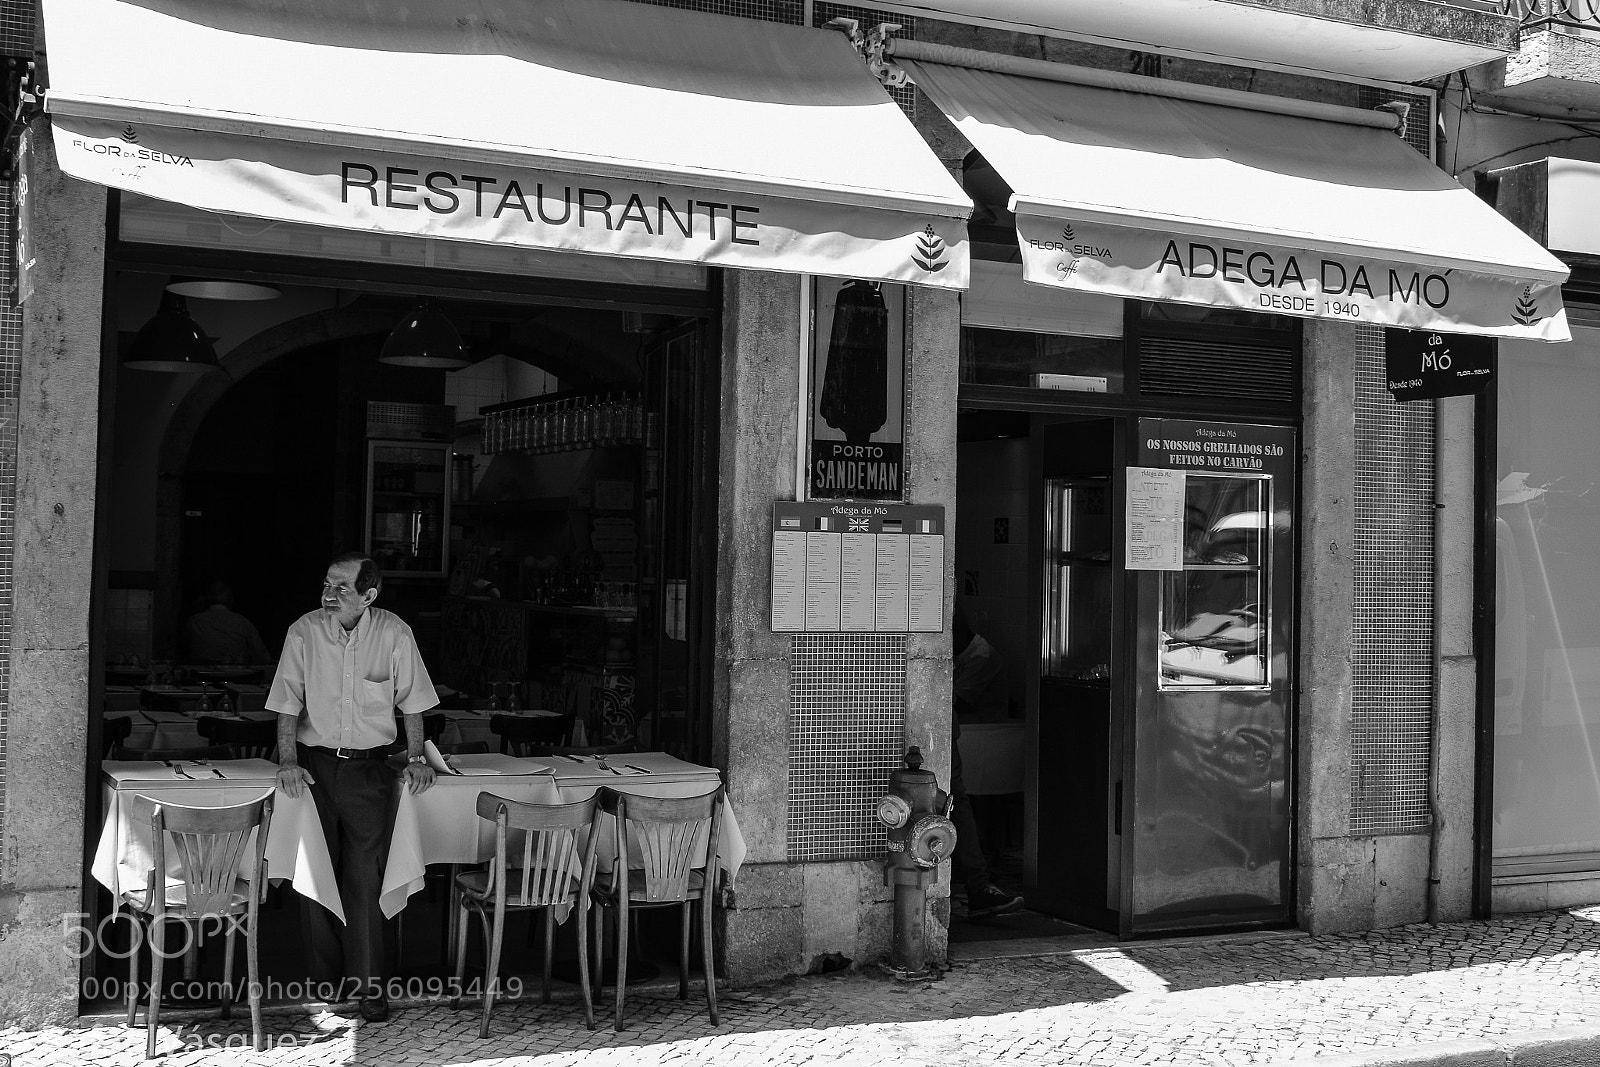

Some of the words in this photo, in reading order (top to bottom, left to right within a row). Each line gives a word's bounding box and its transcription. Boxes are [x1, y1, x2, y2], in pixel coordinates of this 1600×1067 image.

[73, 140, 121, 157] FLOR
[138, 149, 194, 168] SELVA
[341, 161, 760, 247] RESTAURANTE
[1030, 240, 1063, 252] FLOR
[1074, 245, 1113, 259] SELVA
[1156, 239, 1306, 291] ADEGA
[1320, 259, 1374, 300] DA
[1388, 268, 1453, 309] MÓ
[1260, 293, 1315, 312] DESDE
[1324, 301, 1360, 317] 1940
[1428, 333, 1443, 346] da
[1421, 349, 1452, 372] Mó
[1389, 380, 1408, 389] Desde
[1196, 428, 1217, 437] Adega
[833, 445, 883, 458] PORTO
[1146, 438, 1161, 450] OS
[1162, 440, 1201, 452] NOSSOS
[1203, 442, 1262, 455] GRELHADOS
[1264, 443, 1284, 456] SÃO
[1169, 454, 1205, 466] FEITOS
[1207, 456, 1221, 466] NO
[1223, 456, 1263, 468] CARVÃO
[816, 459, 898, 491] SANDEMAN
[830, 505, 859, 516] Adega
[861, 506, 872, 515] da
[874, 506, 888, 515] Mó
